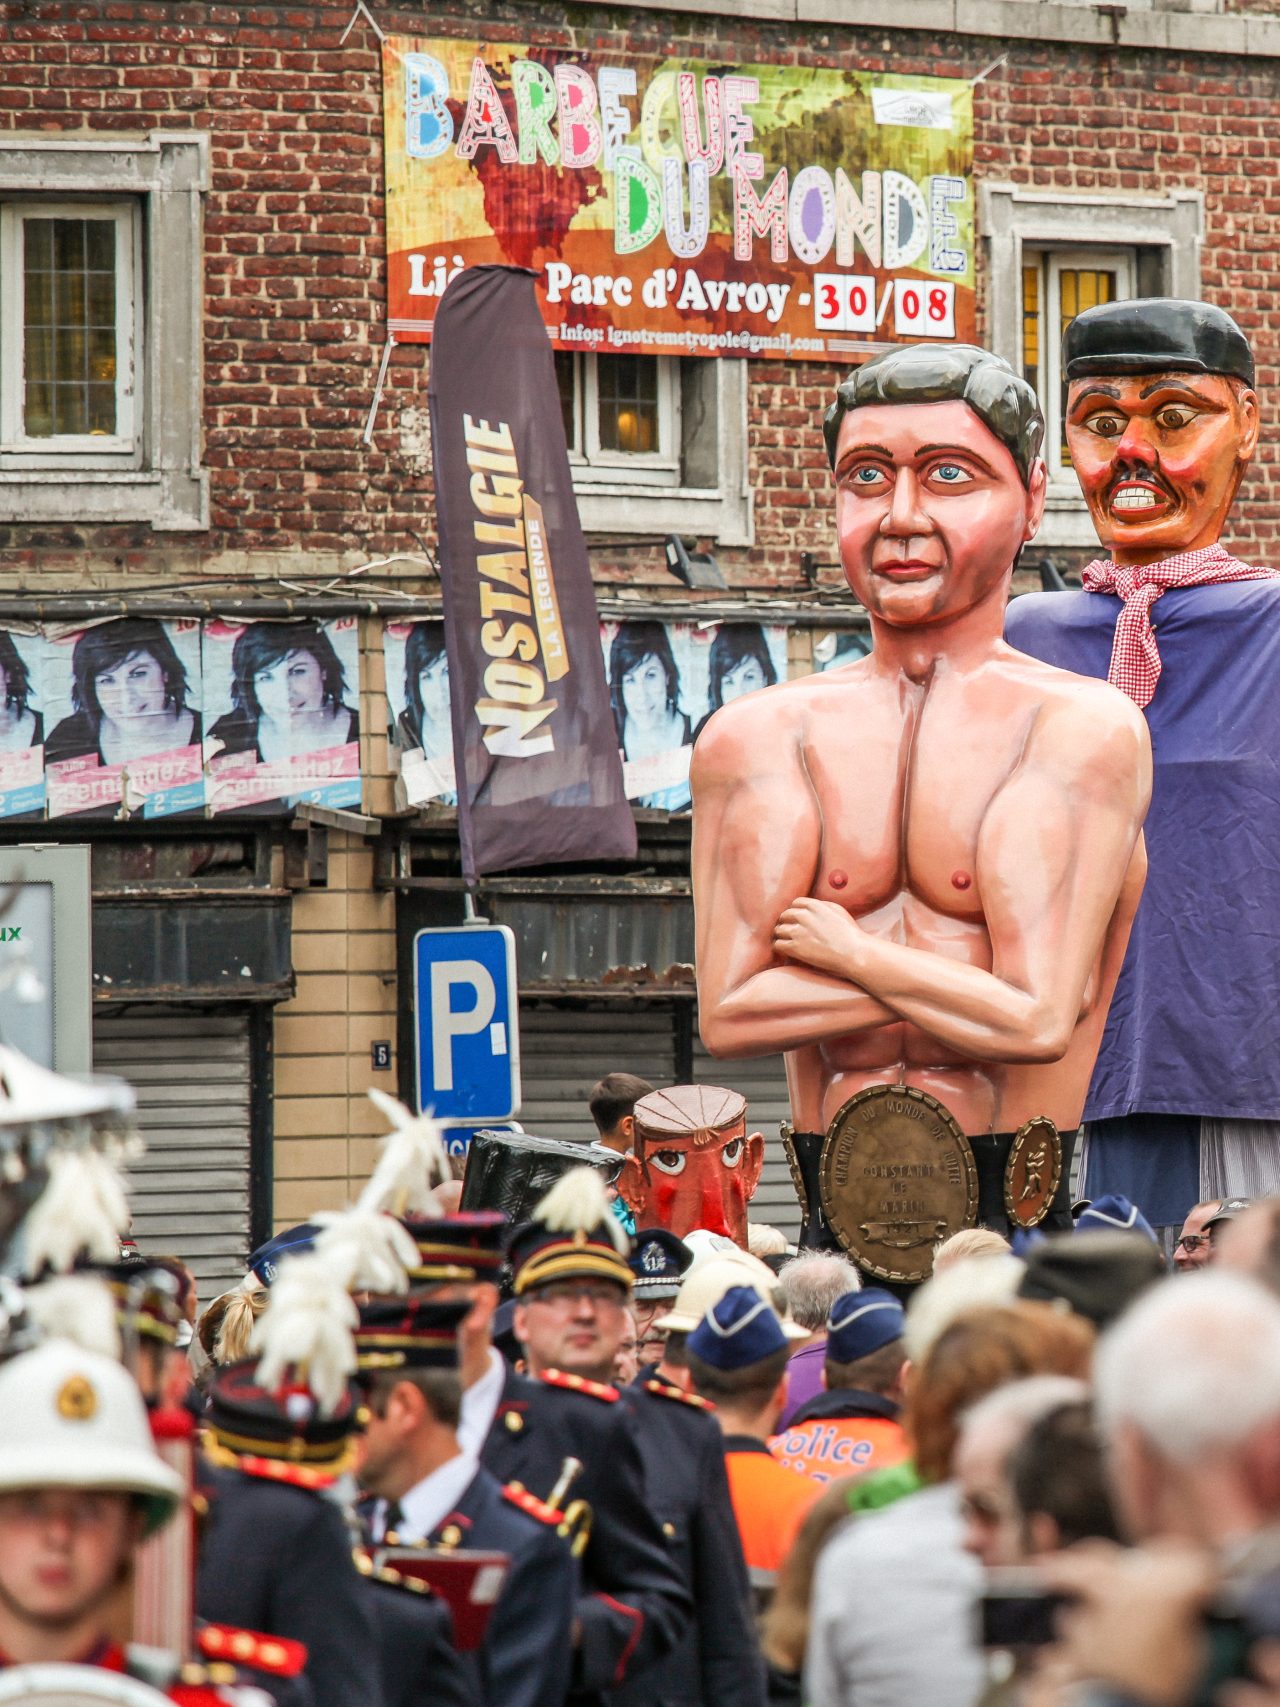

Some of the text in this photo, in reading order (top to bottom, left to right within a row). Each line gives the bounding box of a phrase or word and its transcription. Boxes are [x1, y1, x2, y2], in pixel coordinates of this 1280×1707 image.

[402, 50, 764, 181] BARBECUE
[614, 156, 970, 276] DU MONDE
[544, 262, 633, 306] Parc
[642, 268, 791, 323] d'Avroy
[559, 322, 605, 343] Infos:
[463, 413, 559, 758] NOSTALGIE
[527, 517, 563, 659] LA LEGENDE
[379, 1046, 387, 1065] 5
[431, 959, 496, 1091] P
[836, 1125, 859, 1188] CHAMPION
[861, 1107, 876, 1122] DU
[885, 1099, 926, 1122] MONDE
[863, 1164, 934, 1179] CONSTANT
